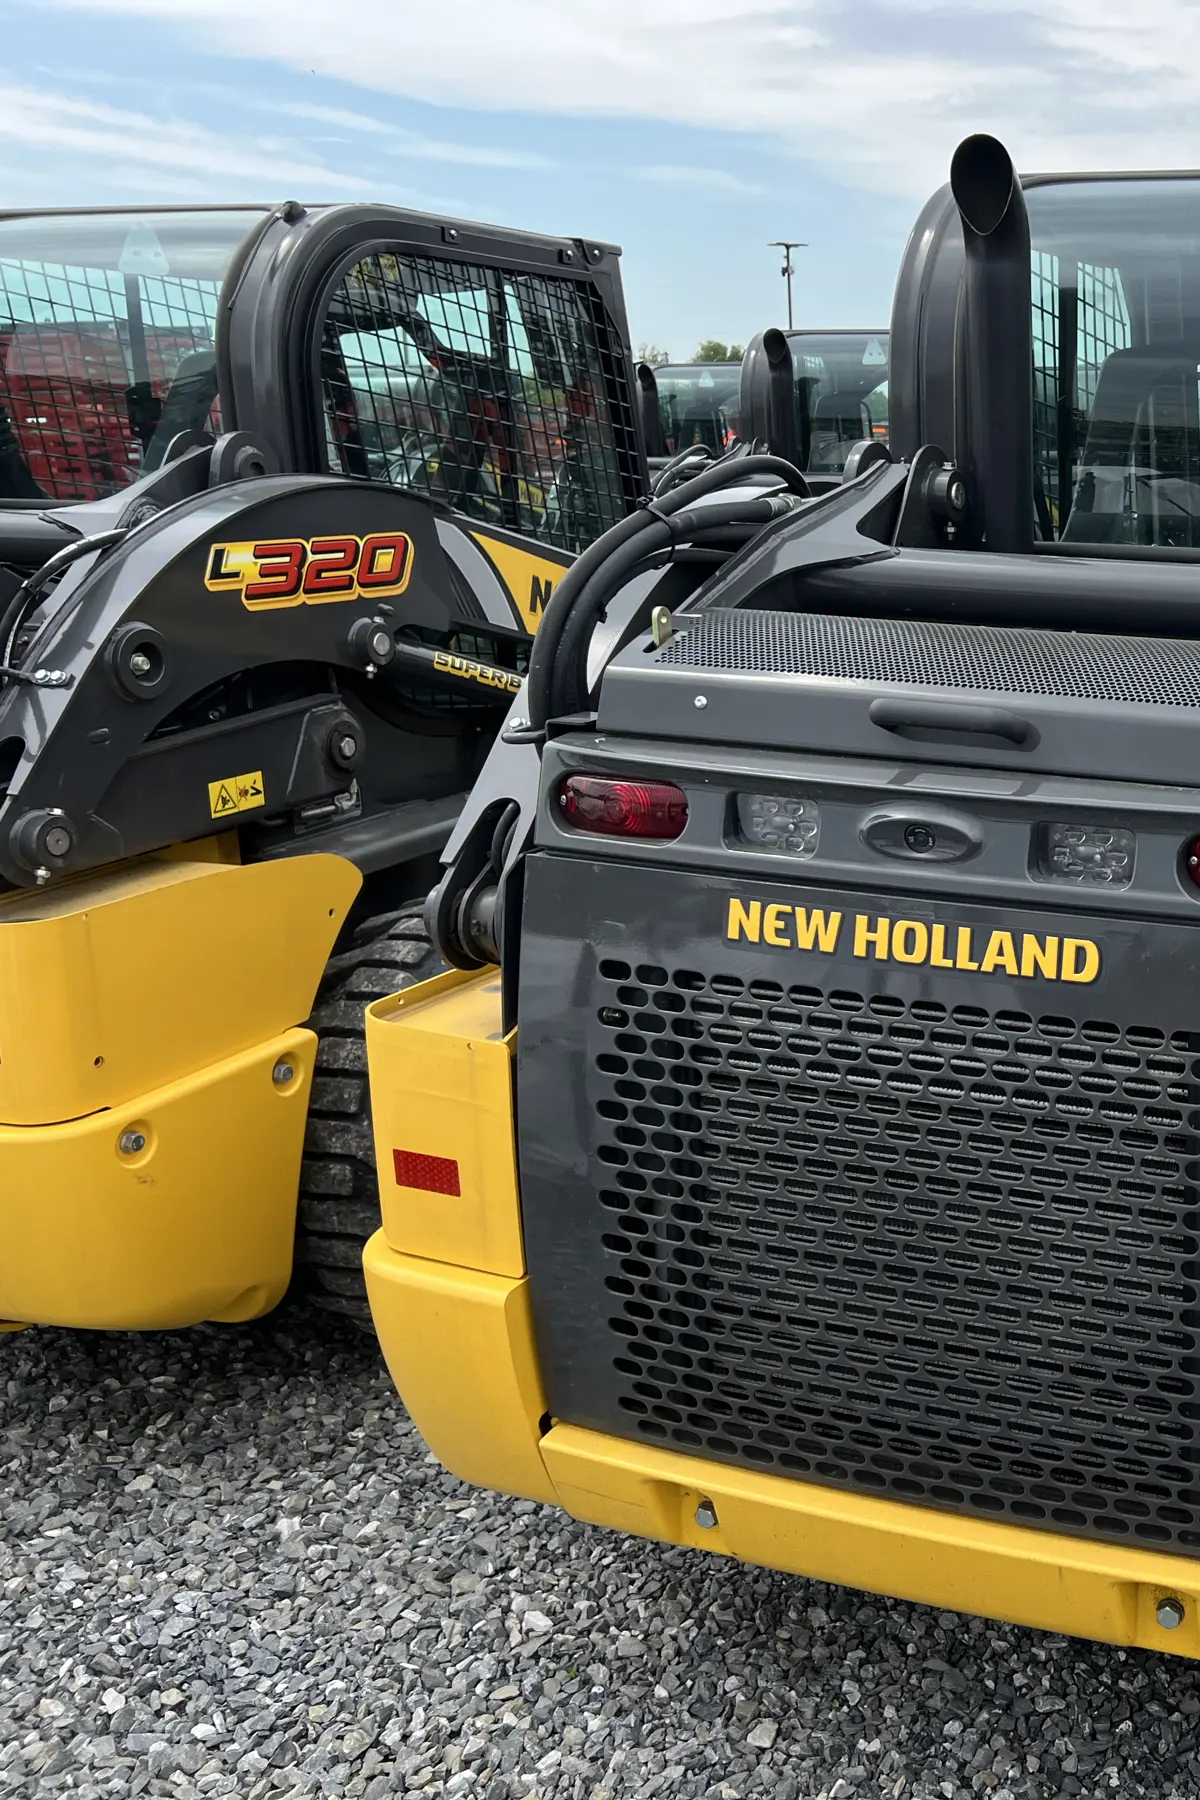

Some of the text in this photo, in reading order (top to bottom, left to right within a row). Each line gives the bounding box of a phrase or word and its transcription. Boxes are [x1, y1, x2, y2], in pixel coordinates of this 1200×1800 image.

[206, 532, 412, 606] L320
[727, 898, 1100, 984] NEW HOLLAND
